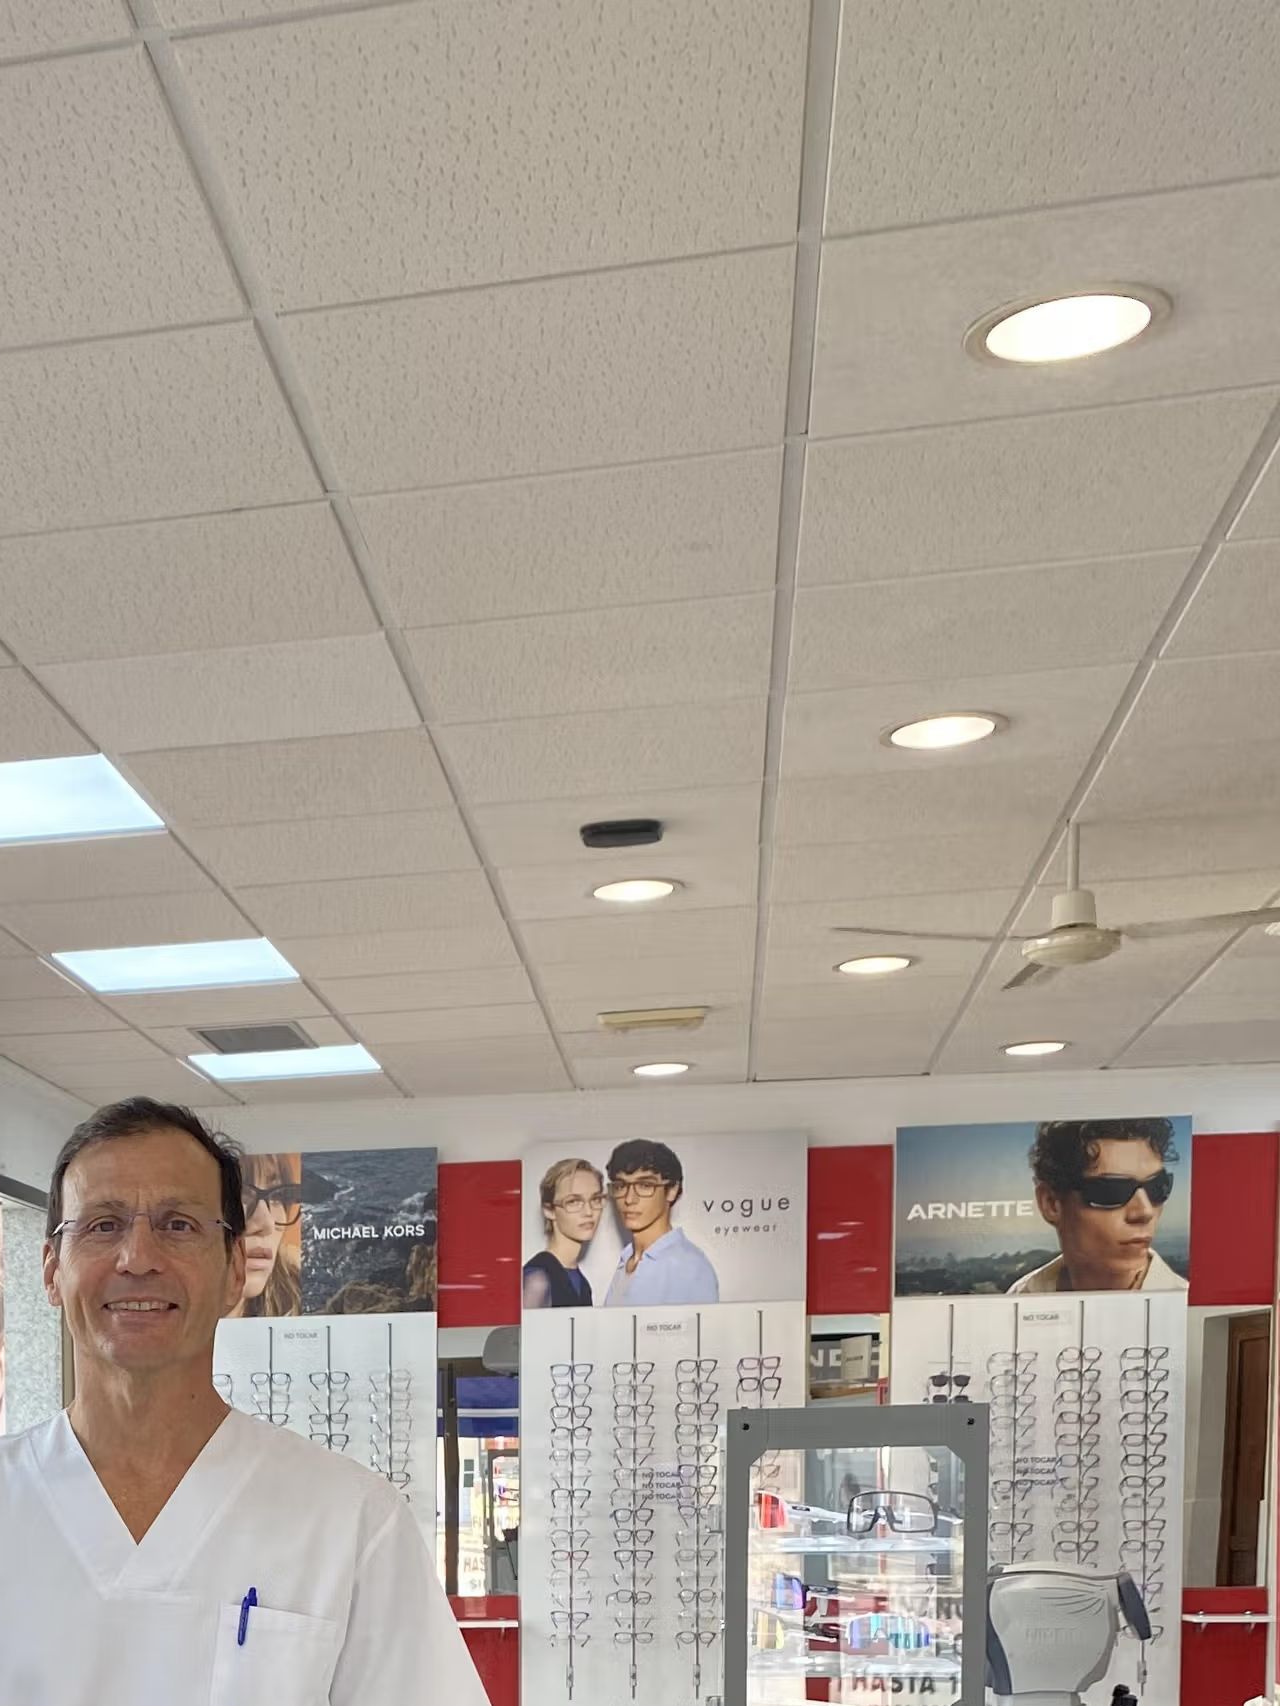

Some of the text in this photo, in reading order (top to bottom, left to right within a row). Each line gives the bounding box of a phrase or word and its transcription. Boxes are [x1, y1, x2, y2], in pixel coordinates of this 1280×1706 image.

[703, 1197, 790, 1218] vogue
[907, 1200, 1035, 1220] ARNETTE
[313, 1224, 425, 1240] MICHAEL KORS
[714, 1224, 777, 1236] eyewear
